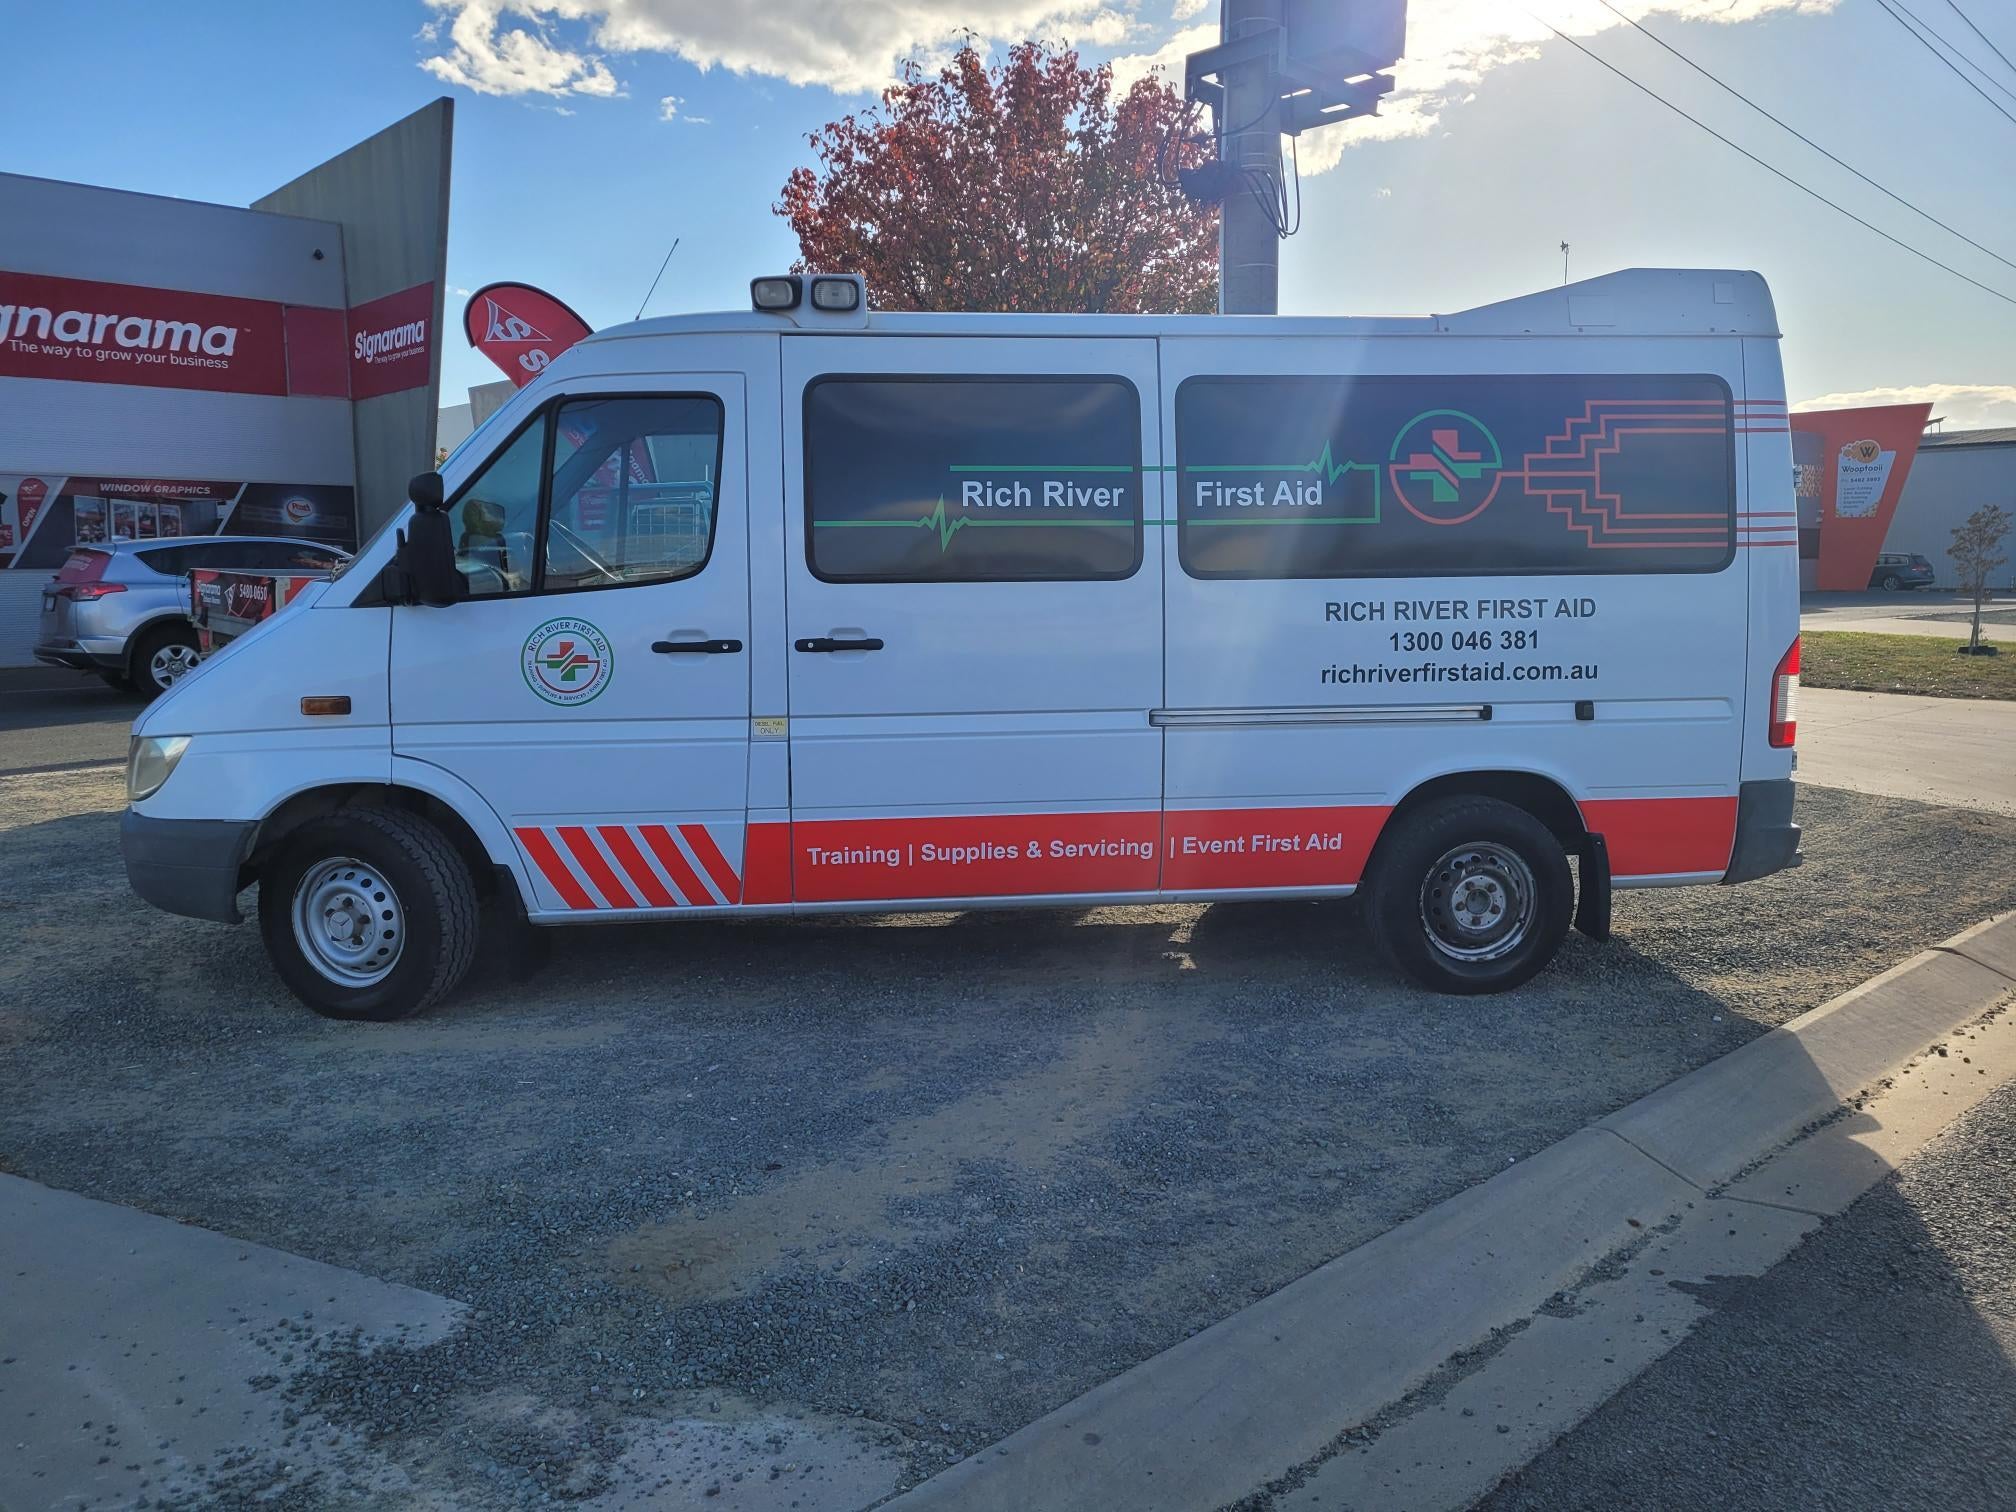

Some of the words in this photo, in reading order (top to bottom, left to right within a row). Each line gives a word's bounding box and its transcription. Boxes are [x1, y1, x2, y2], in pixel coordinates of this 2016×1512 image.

[8, 339, 38, 353] The
[41, 344, 72, 358] way
[76, 346, 92, 358] to
[96, 349, 132, 362] grow
[135, 351, 167, 364] your
[170, 353, 229, 369] business
[355, 320, 424, 363] Signarama
[100, 483, 151, 492] WINDOW
[153, 485, 210, 494] GRAPHICS
[962, 481, 1032, 507] Rich
[1043, 481, 1125, 507] River
[1196, 481, 1265, 507] First
[1271, 480, 1322, 506] Aid
[22, 506, 37, 527] OPEN
[1325, 601, 1385, 621] RICH
[1394, 600, 1470, 621] RIVER
[1478, 599, 1548, 619] FIRST
[1554, 598, 1597, 618] AID
[527, 632, 545, 652] RICH
[545, 621, 570, 634] RIVER
[573, 622, 596, 638] FIRST
[593, 637, 606, 652] AID
[1390, 631, 1443, 652] 1300
[1451, 631, 1493, 651] 046
[1500, 630, 1539, 650] 381
[1320, 662, 1599, 684] richriverfirstaid.com.au
[807, 846, 900, 866] Training
[921, 842, 1019, 864] Supplies
[1026, 840, 1042, 858] &
[1050, 838, 1154, 859] Servicing
[1183, 836, 1245, 854] Event
[1251, 834, 1300, 852] First
[1305, 833, 1342, 851] Aid
